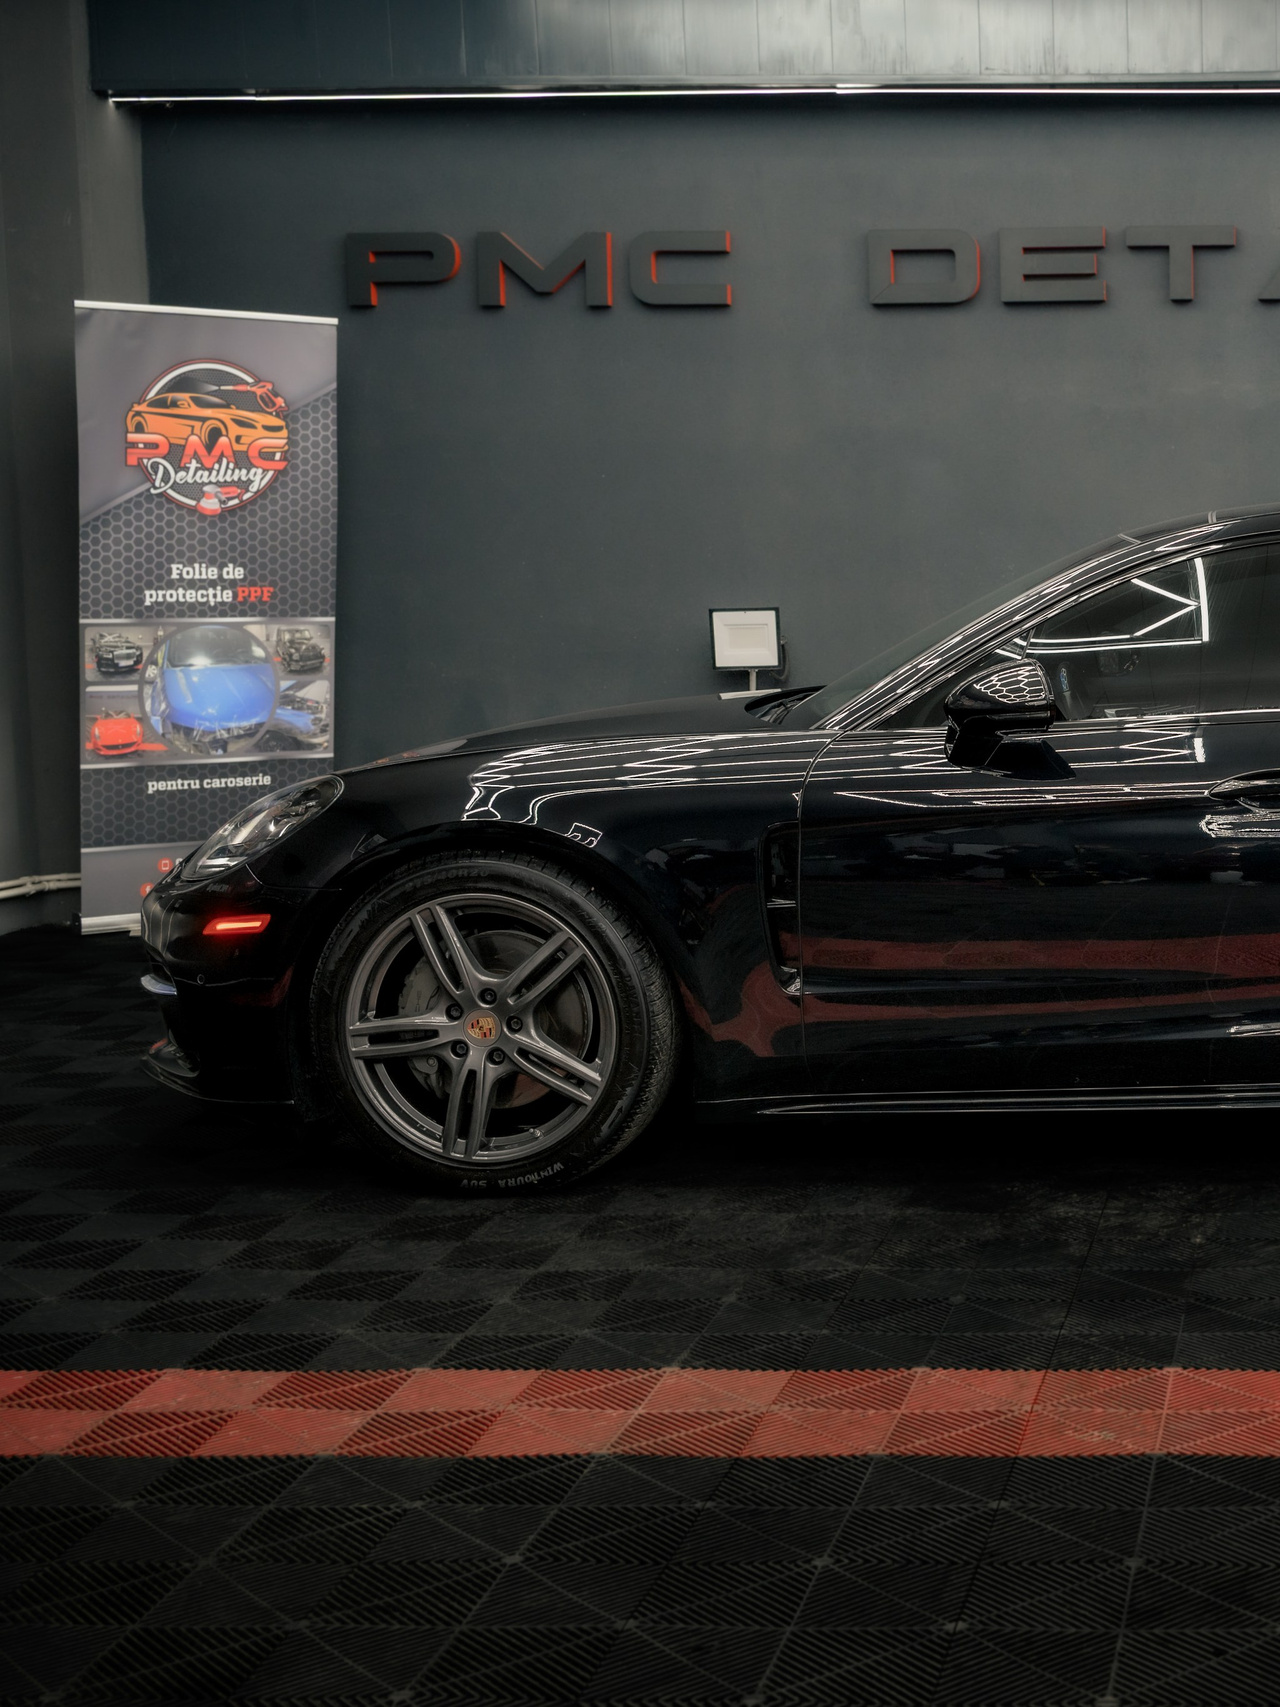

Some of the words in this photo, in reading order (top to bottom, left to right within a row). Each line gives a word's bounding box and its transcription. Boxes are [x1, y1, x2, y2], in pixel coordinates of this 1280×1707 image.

[345, 231, 732, 307] PMC
[126, 433, 289, 470] PMC
[147, 457, 265, 494] Detailing
[170, 563, 218, 579] Folie
[222, 563, 244, 579] de
[236, 586, 274, 602] PPF
[147, 778, 200, 794] pentru
[203, 773, 272, 788] caroserie
[459, 1179, 487, 1190] SUV
[497, 1161, 565, 1189] WINTOURA
